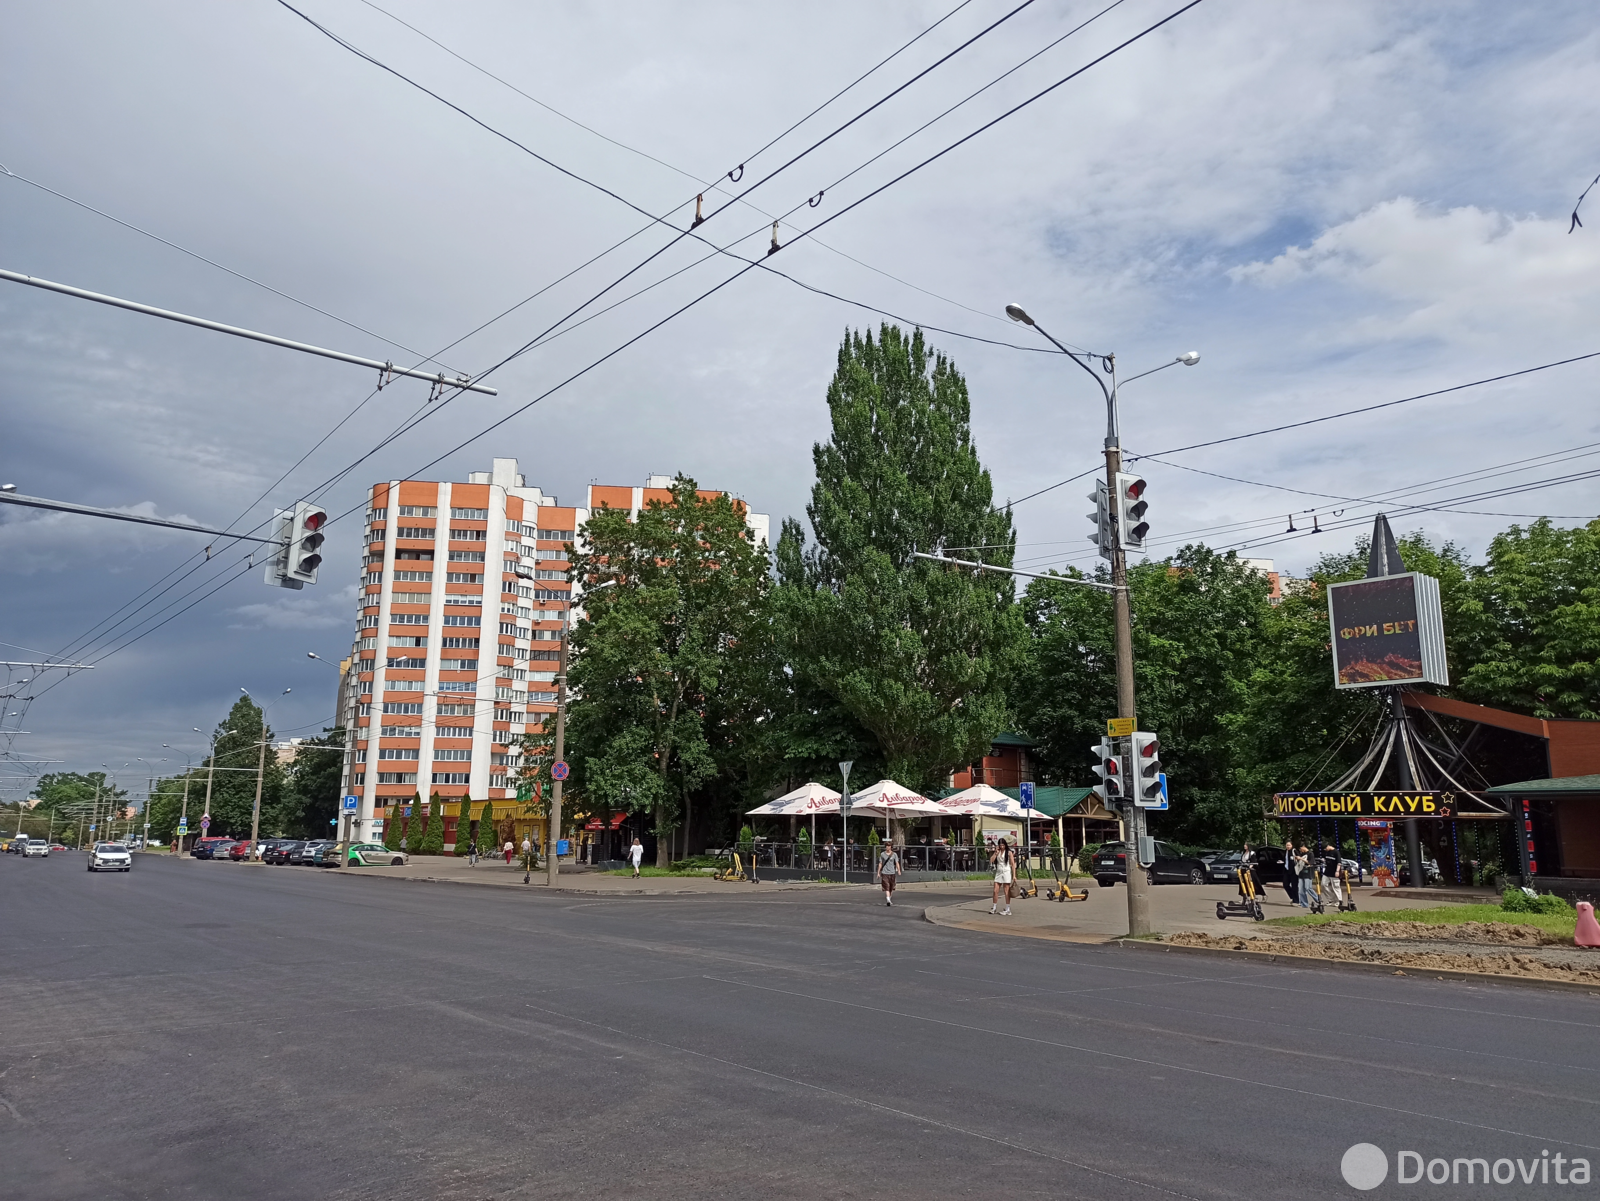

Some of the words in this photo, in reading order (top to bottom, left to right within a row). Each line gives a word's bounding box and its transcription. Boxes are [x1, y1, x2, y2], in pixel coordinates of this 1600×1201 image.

[1340, 624, 1378, 639] ФРИ
[1382, 620, 1416, 635] БЕТ
[347, 797, 355, 807] P
[1278, 793, 1361, 813] ИГОРНЫЙ
[1374, 795, 1437, 812] КЛУБ
